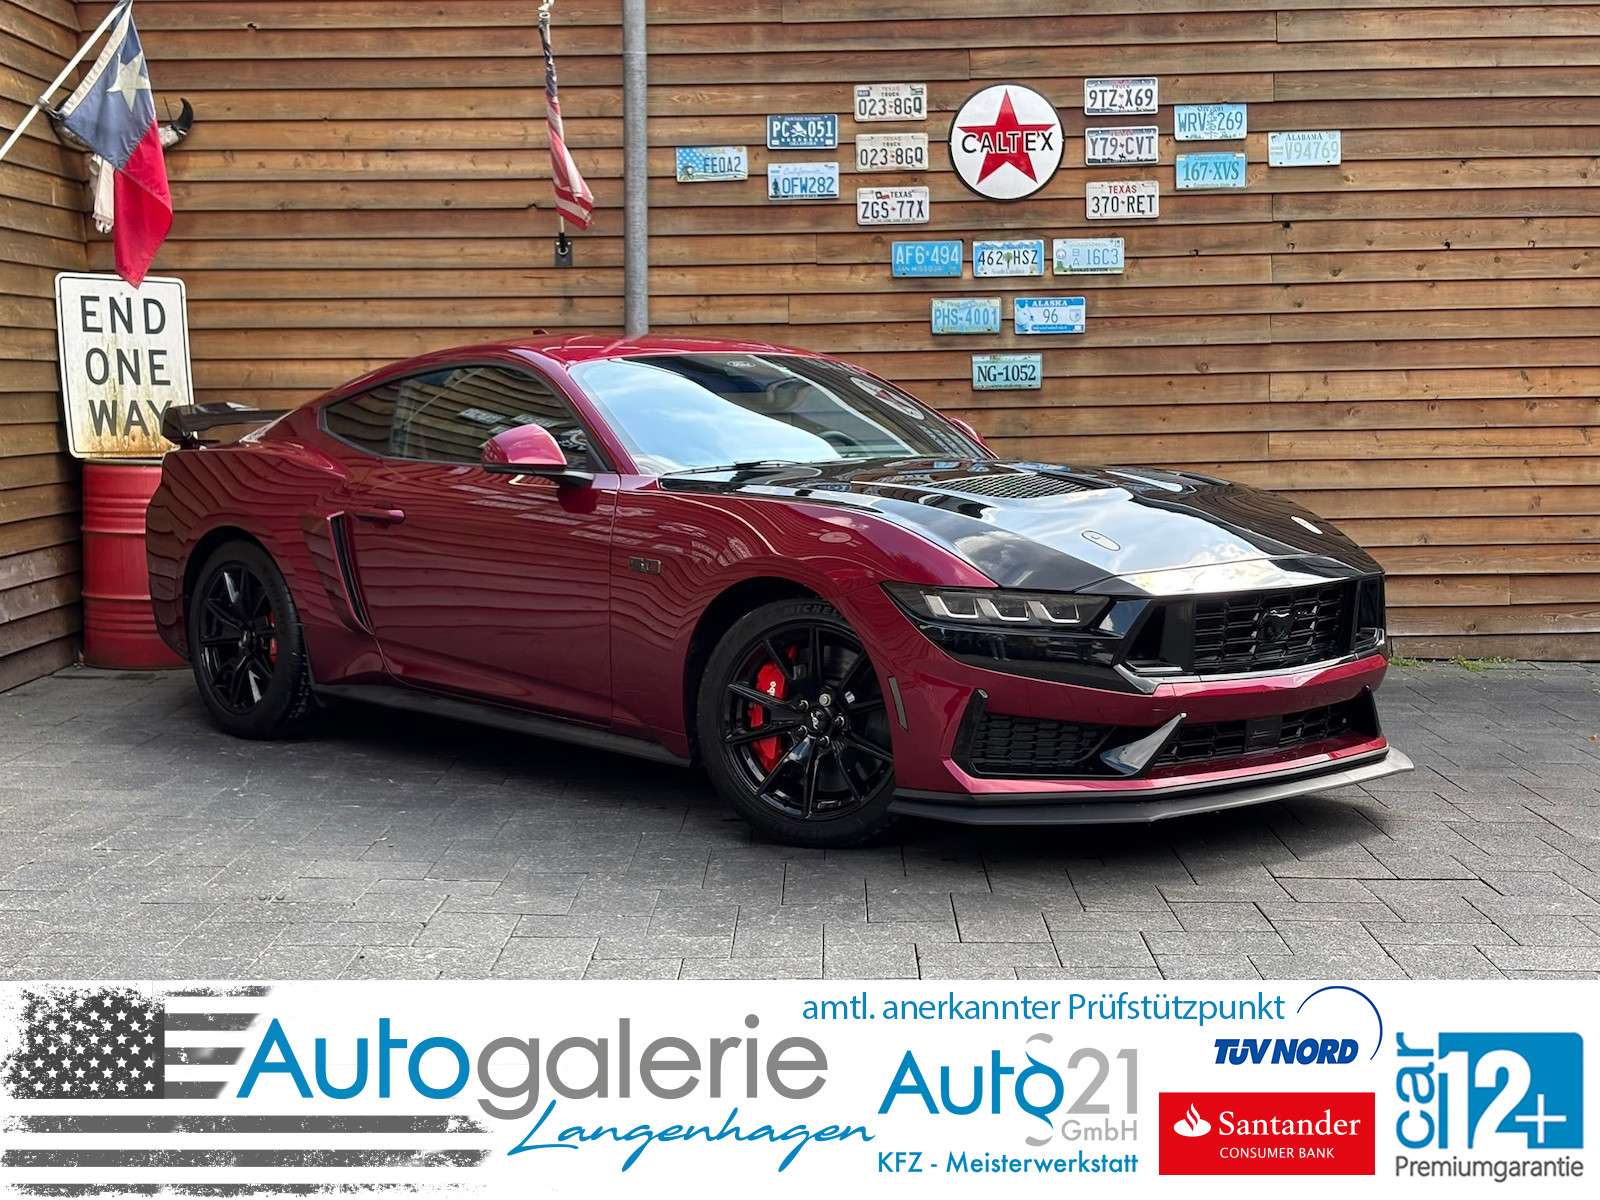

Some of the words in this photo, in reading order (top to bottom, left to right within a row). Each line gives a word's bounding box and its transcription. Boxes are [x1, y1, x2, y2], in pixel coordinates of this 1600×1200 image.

[961, 131, 1054, 153] CALTEX
[1285, 132, 1323, 141] ALABAMA
[890, 191, 913, 199] TEXAS
[1108, 185, 1137, 195] TEXAS
[80, 295, 166, 335] END
[1042, 308, 1059, 324] 96
[85, 347, 171, 386] ONE
[976, 364, 1037, 382] NG-1052
[88, 399, 173, 437] WAY
